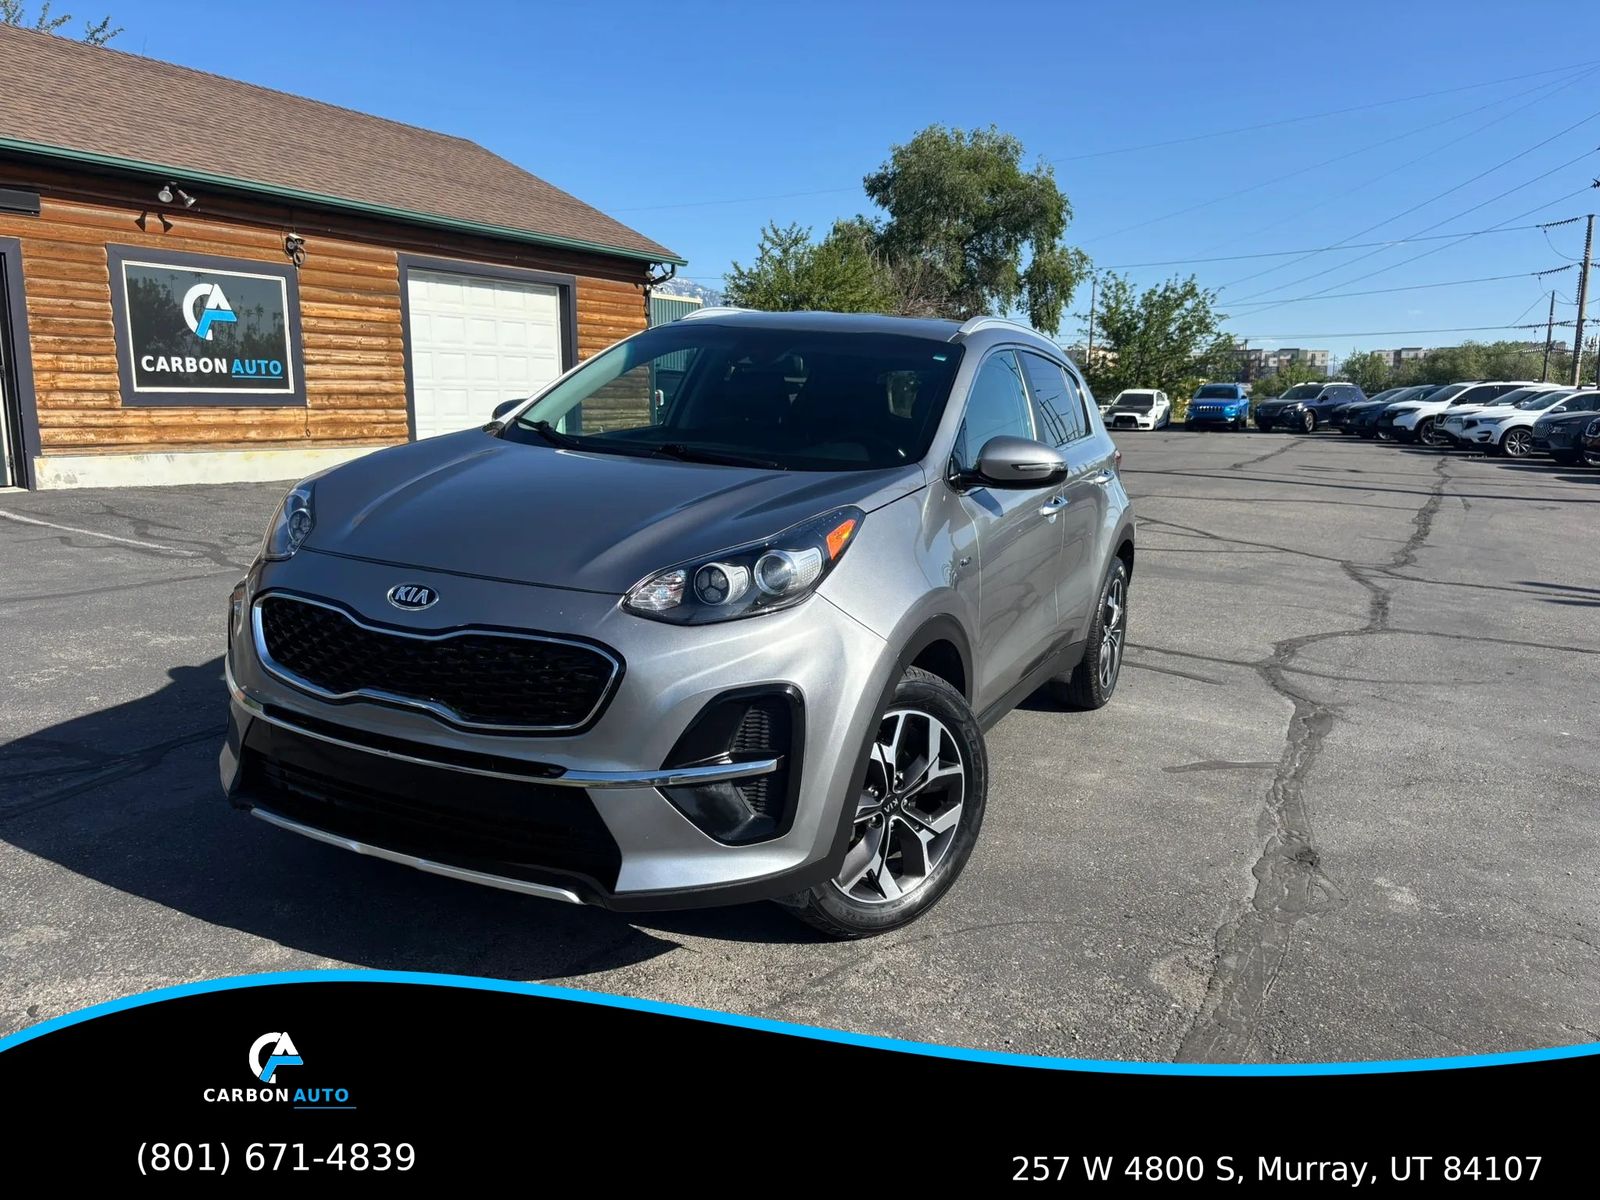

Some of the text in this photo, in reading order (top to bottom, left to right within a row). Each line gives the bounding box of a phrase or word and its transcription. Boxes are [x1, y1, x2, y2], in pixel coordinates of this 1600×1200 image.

[141, 355, 282, 375] CARBON AUTO
[394, 586, 429, 605] KIA
